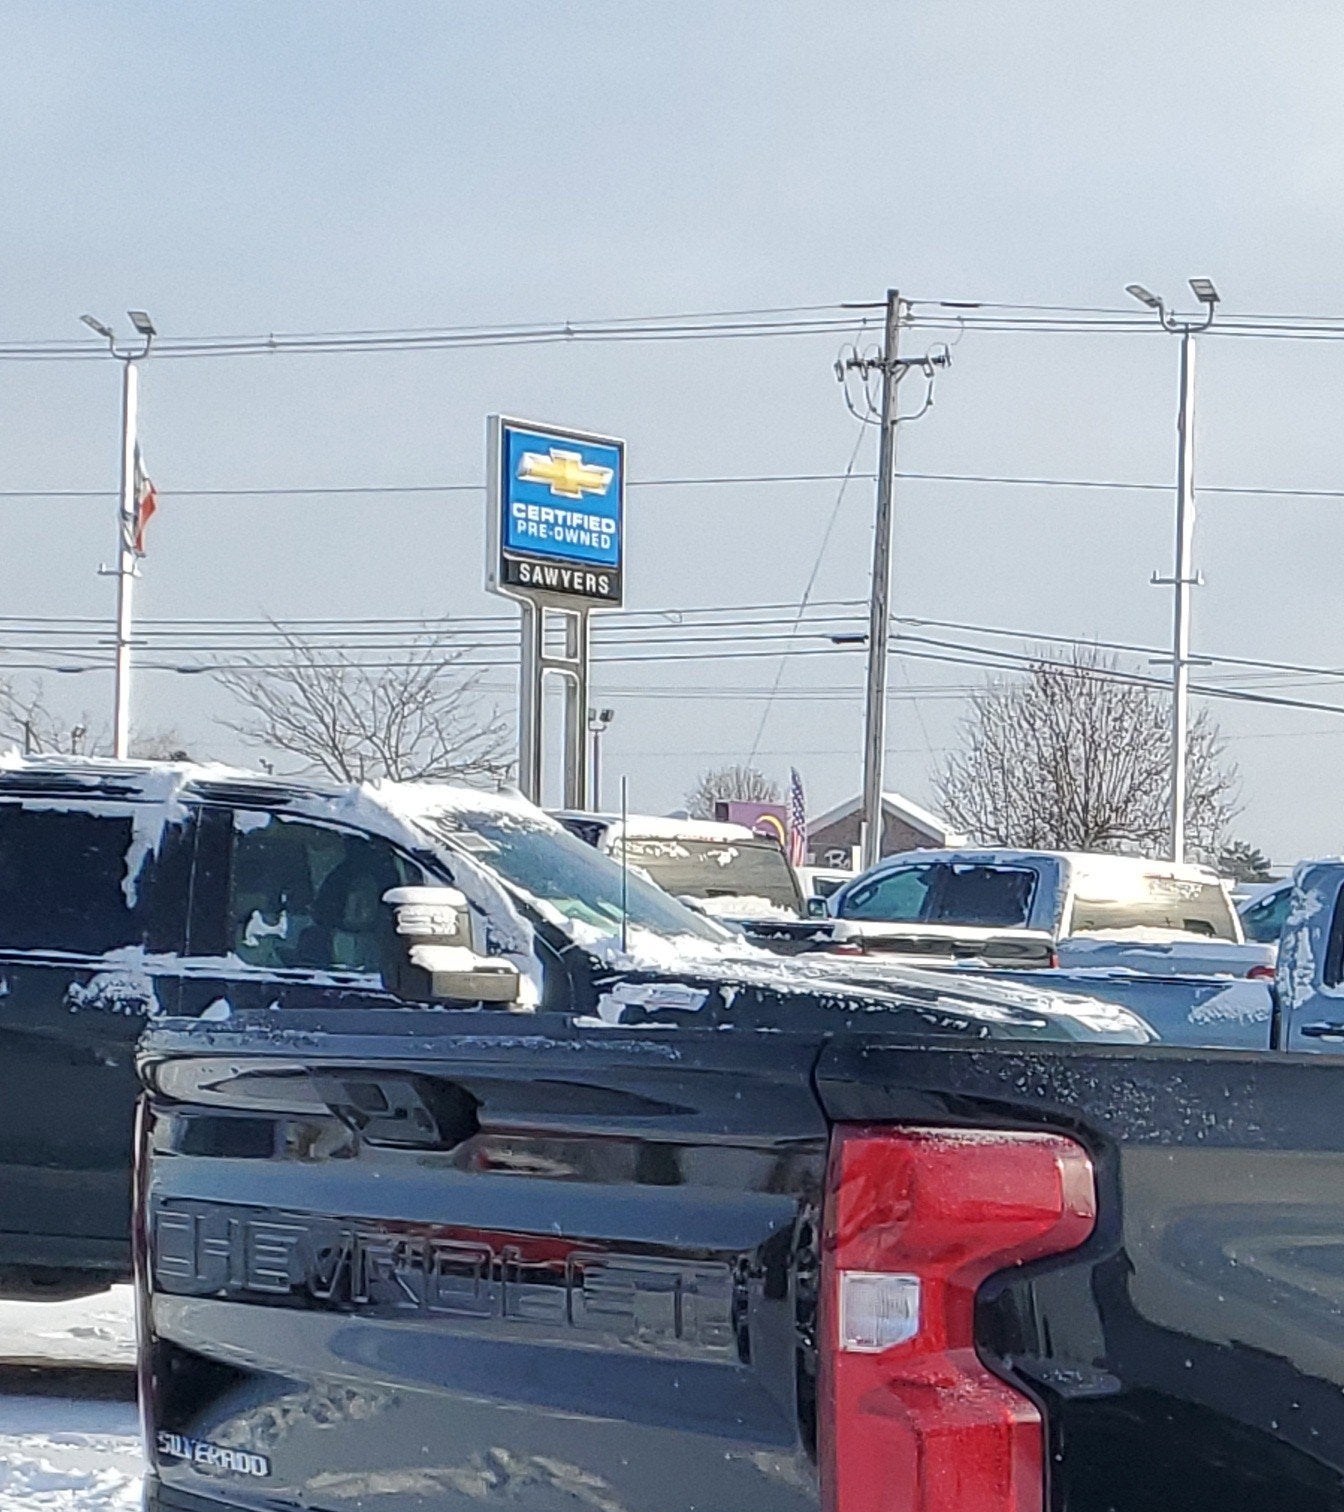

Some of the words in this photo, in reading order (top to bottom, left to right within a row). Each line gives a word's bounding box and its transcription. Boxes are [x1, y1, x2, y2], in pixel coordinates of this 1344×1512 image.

[512, 503, 616, 534] CERTIFIED
[517, 519, 611, 549] PRE-OWNED
[519, 563, 610, 594] SAWYERS
[155, 1208, 732, 1340] CHEVROLET
[158, 1431, 269, 1477] SILVERADO
